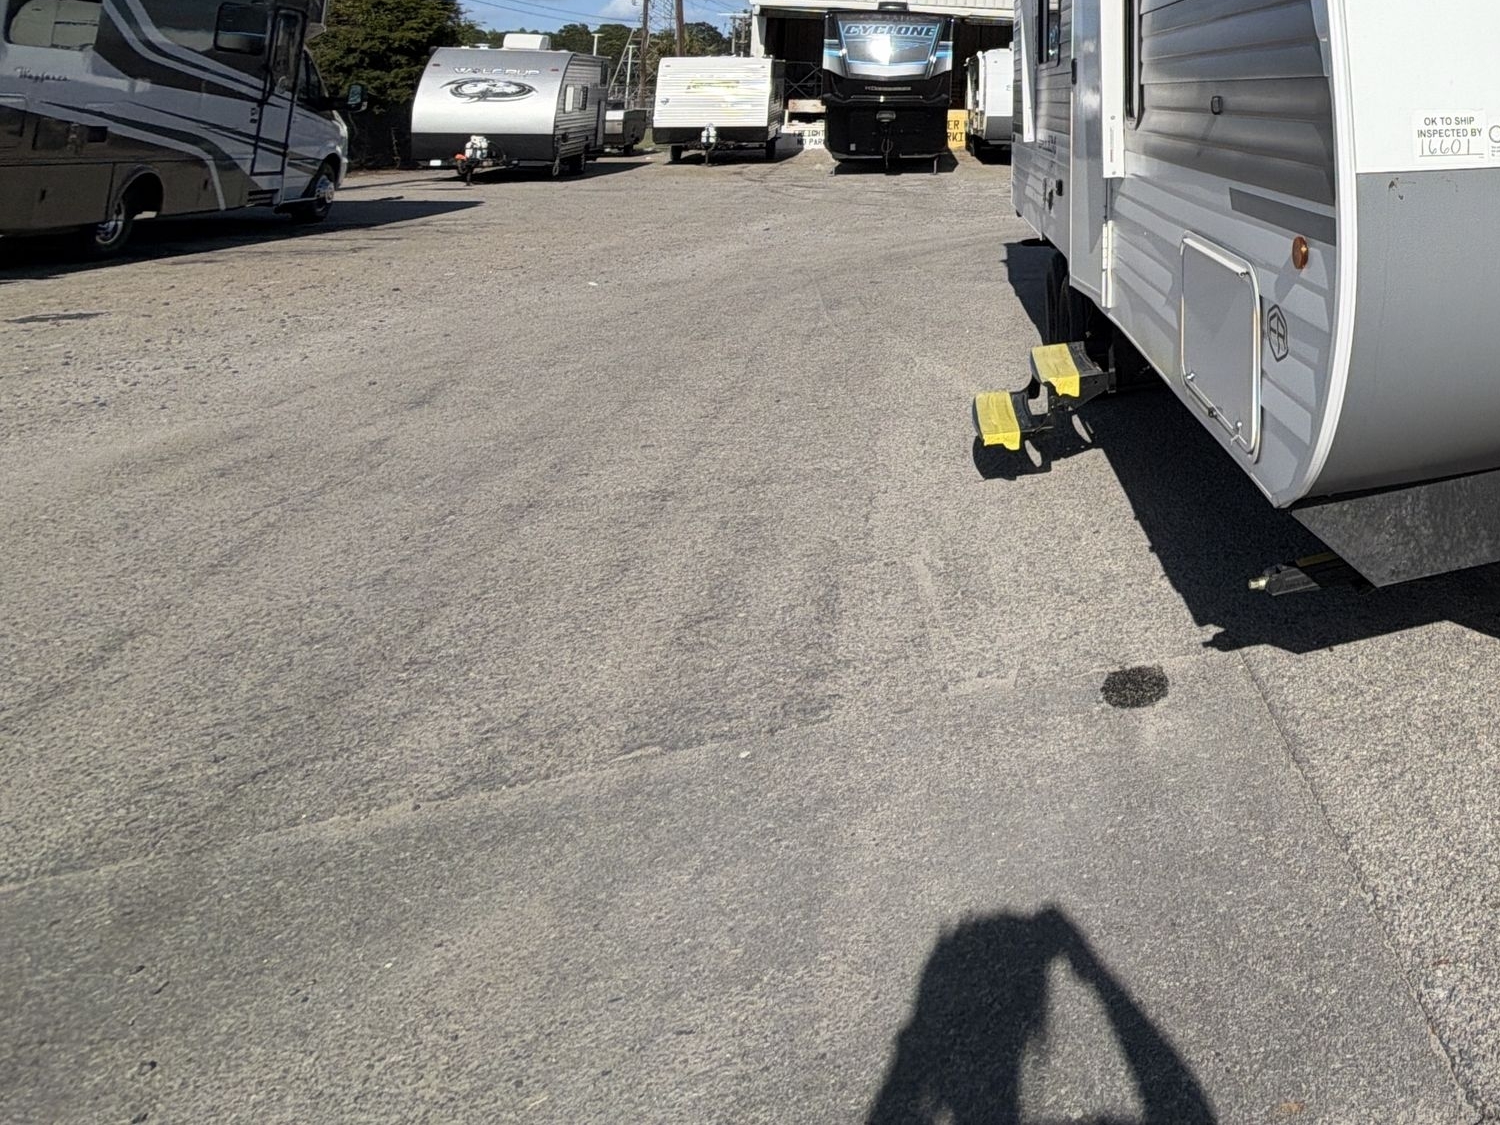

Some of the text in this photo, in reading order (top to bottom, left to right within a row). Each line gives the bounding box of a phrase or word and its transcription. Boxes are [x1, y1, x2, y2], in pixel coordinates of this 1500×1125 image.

[844, 24, 938, 38] CYCLONE
[1424, 116, 1475, 126] OK TO SHIP
[1417, 128, 1483, 138] INSPECTED BY
[1421, 138, 1470, 155] 16601
